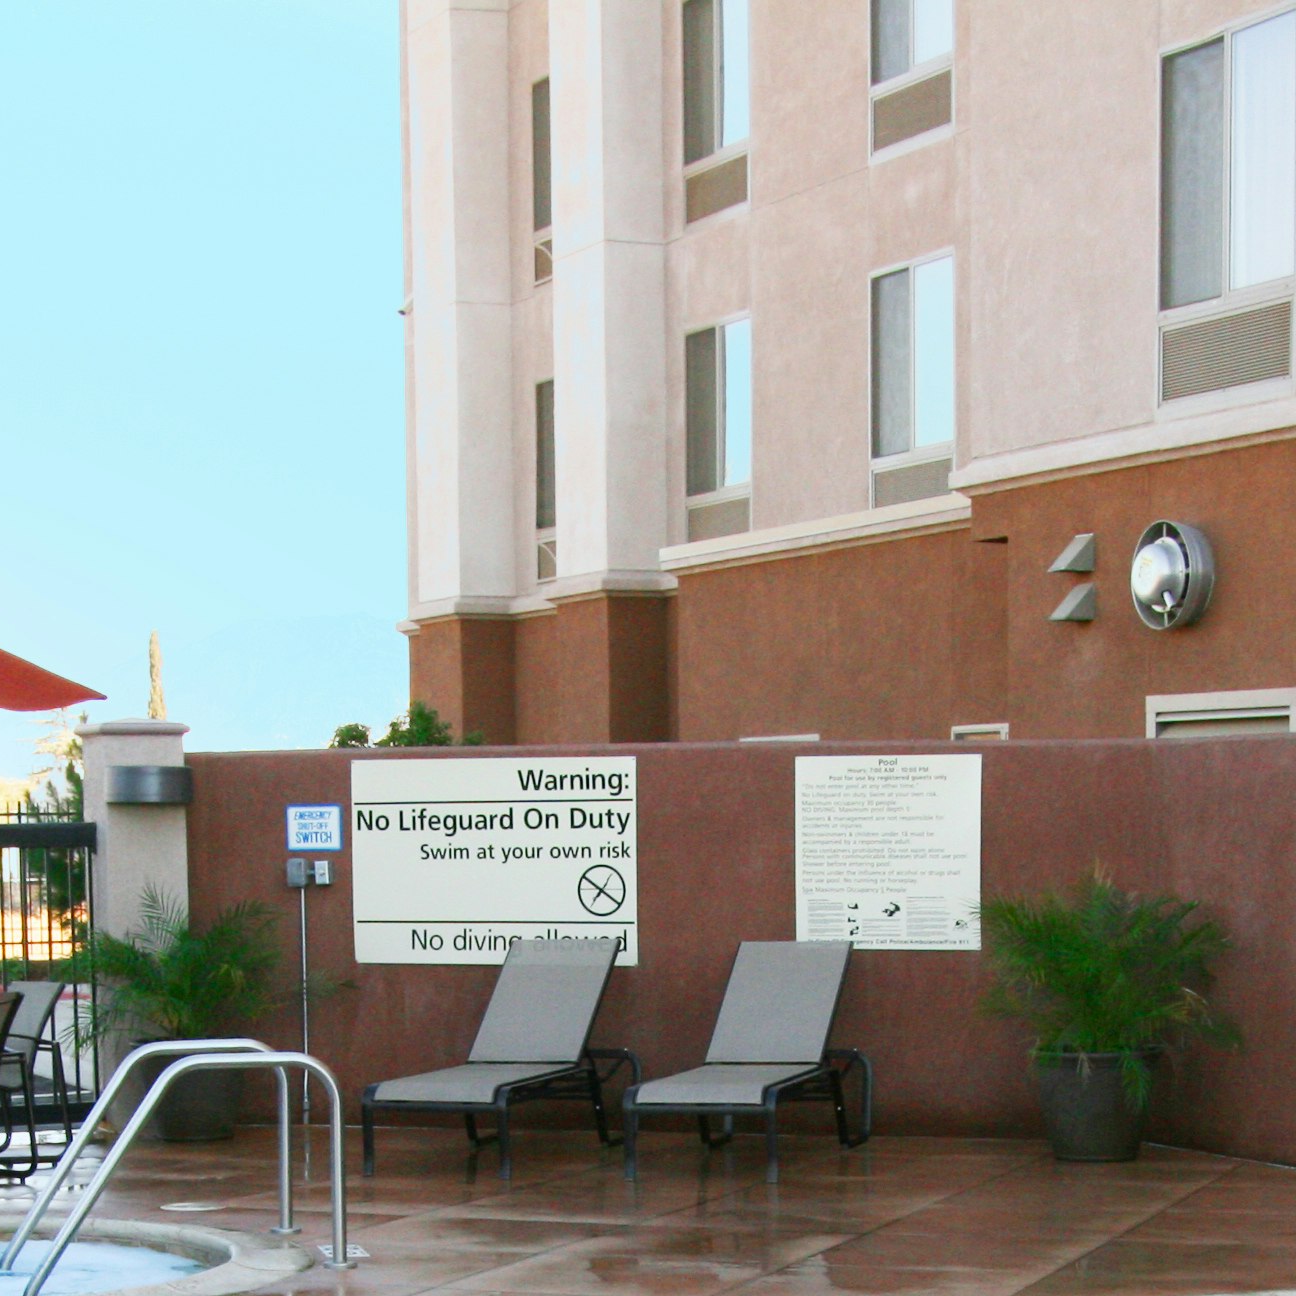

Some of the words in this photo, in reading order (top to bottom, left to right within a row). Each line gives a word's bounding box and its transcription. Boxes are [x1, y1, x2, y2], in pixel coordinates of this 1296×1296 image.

[878, 758, 898, 766] Pool
[517, 767, 629, 796] Warning:
[294, 811, 332, 820] EMERGENCY
[356, 809, 390, 831] No
[399, 807, 514, 837] Lifeguard
[524, 808, 559, 830] On
[570, 807, 630, 835] Duty
[296, 831, 332, 843] SWITCH
[420, 843, 470, 860] Swim
[477, 844, 495, 859] at
[501, 846, 543, 864] your
[549, 845, 592, 859] own
[599, 841, 631, 859] risk
[411, 929, 444, 951] No
